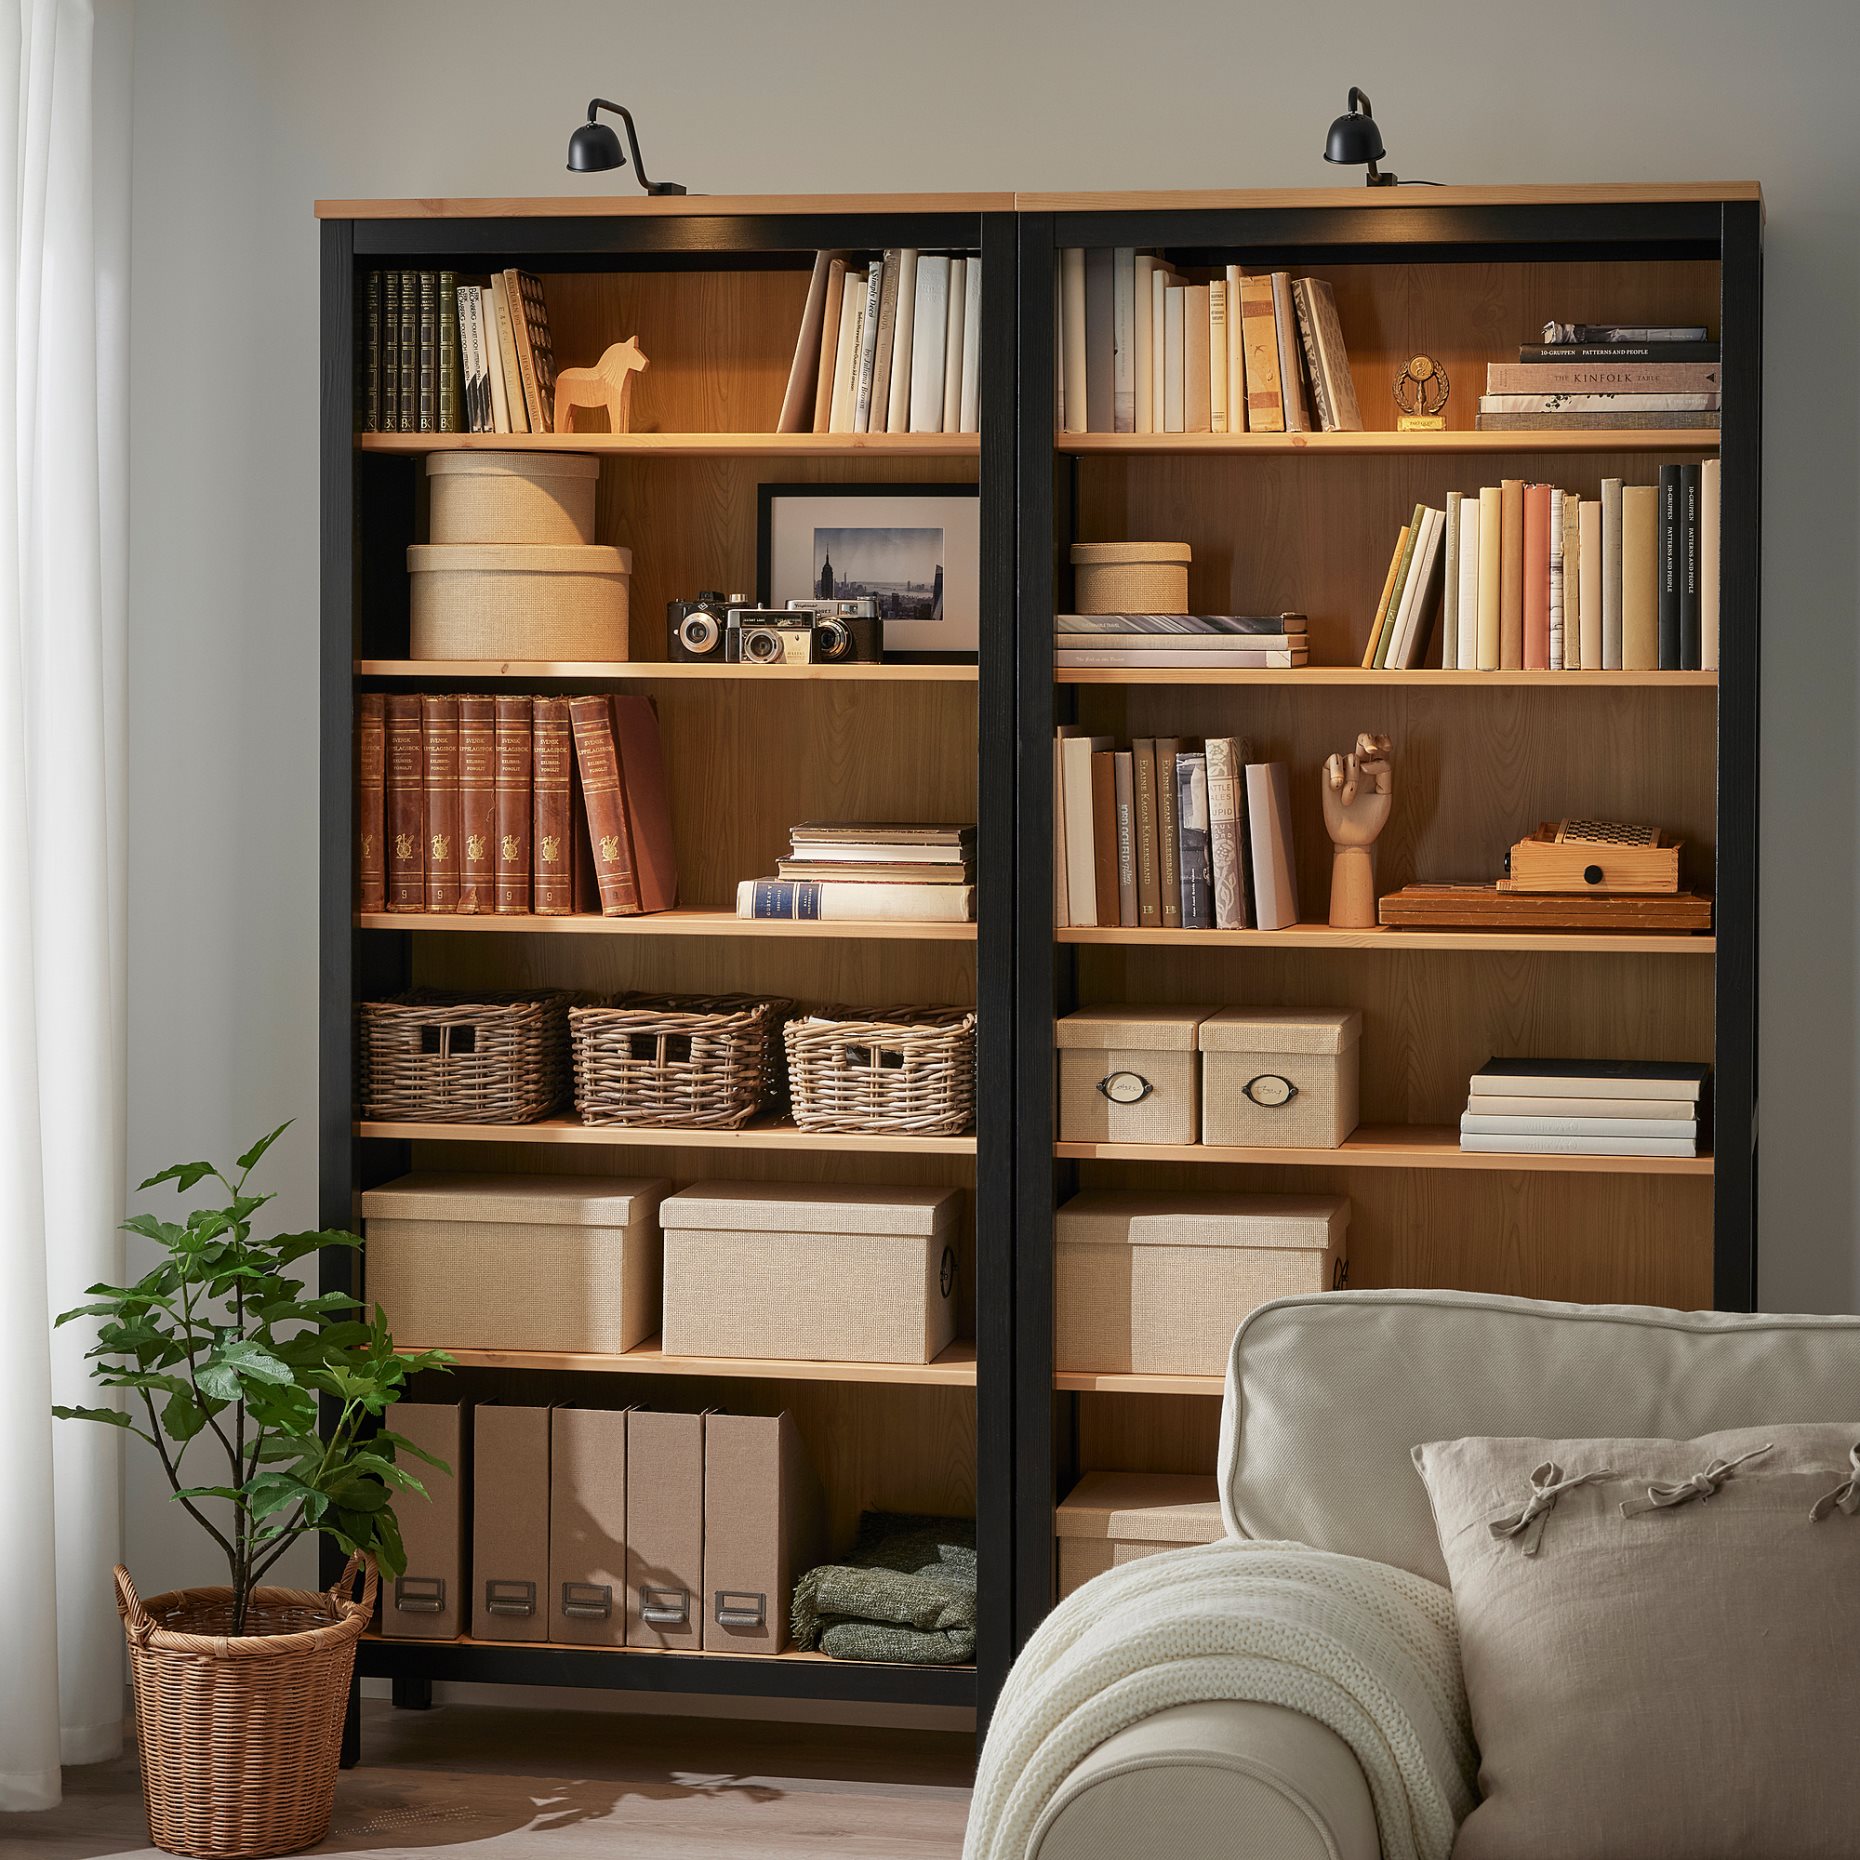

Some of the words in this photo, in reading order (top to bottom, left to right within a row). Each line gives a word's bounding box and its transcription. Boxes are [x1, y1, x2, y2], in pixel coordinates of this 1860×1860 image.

[869, 272, 879, 298] Simply
[864, 348, 872, 358] by
[862, 358, 871, 384] Juliana
[1574, 374, 1632, 382] KINFOLK
[1141, 794, 1150, 822] KAGAN
[1164, 793, 1172, 823] KAGAN
[402, 890, 407, 899] 9
[438, 890, 443, 899] 9
[506, 892, 512, 900] 9
[547, 892, 553, 901] 9
